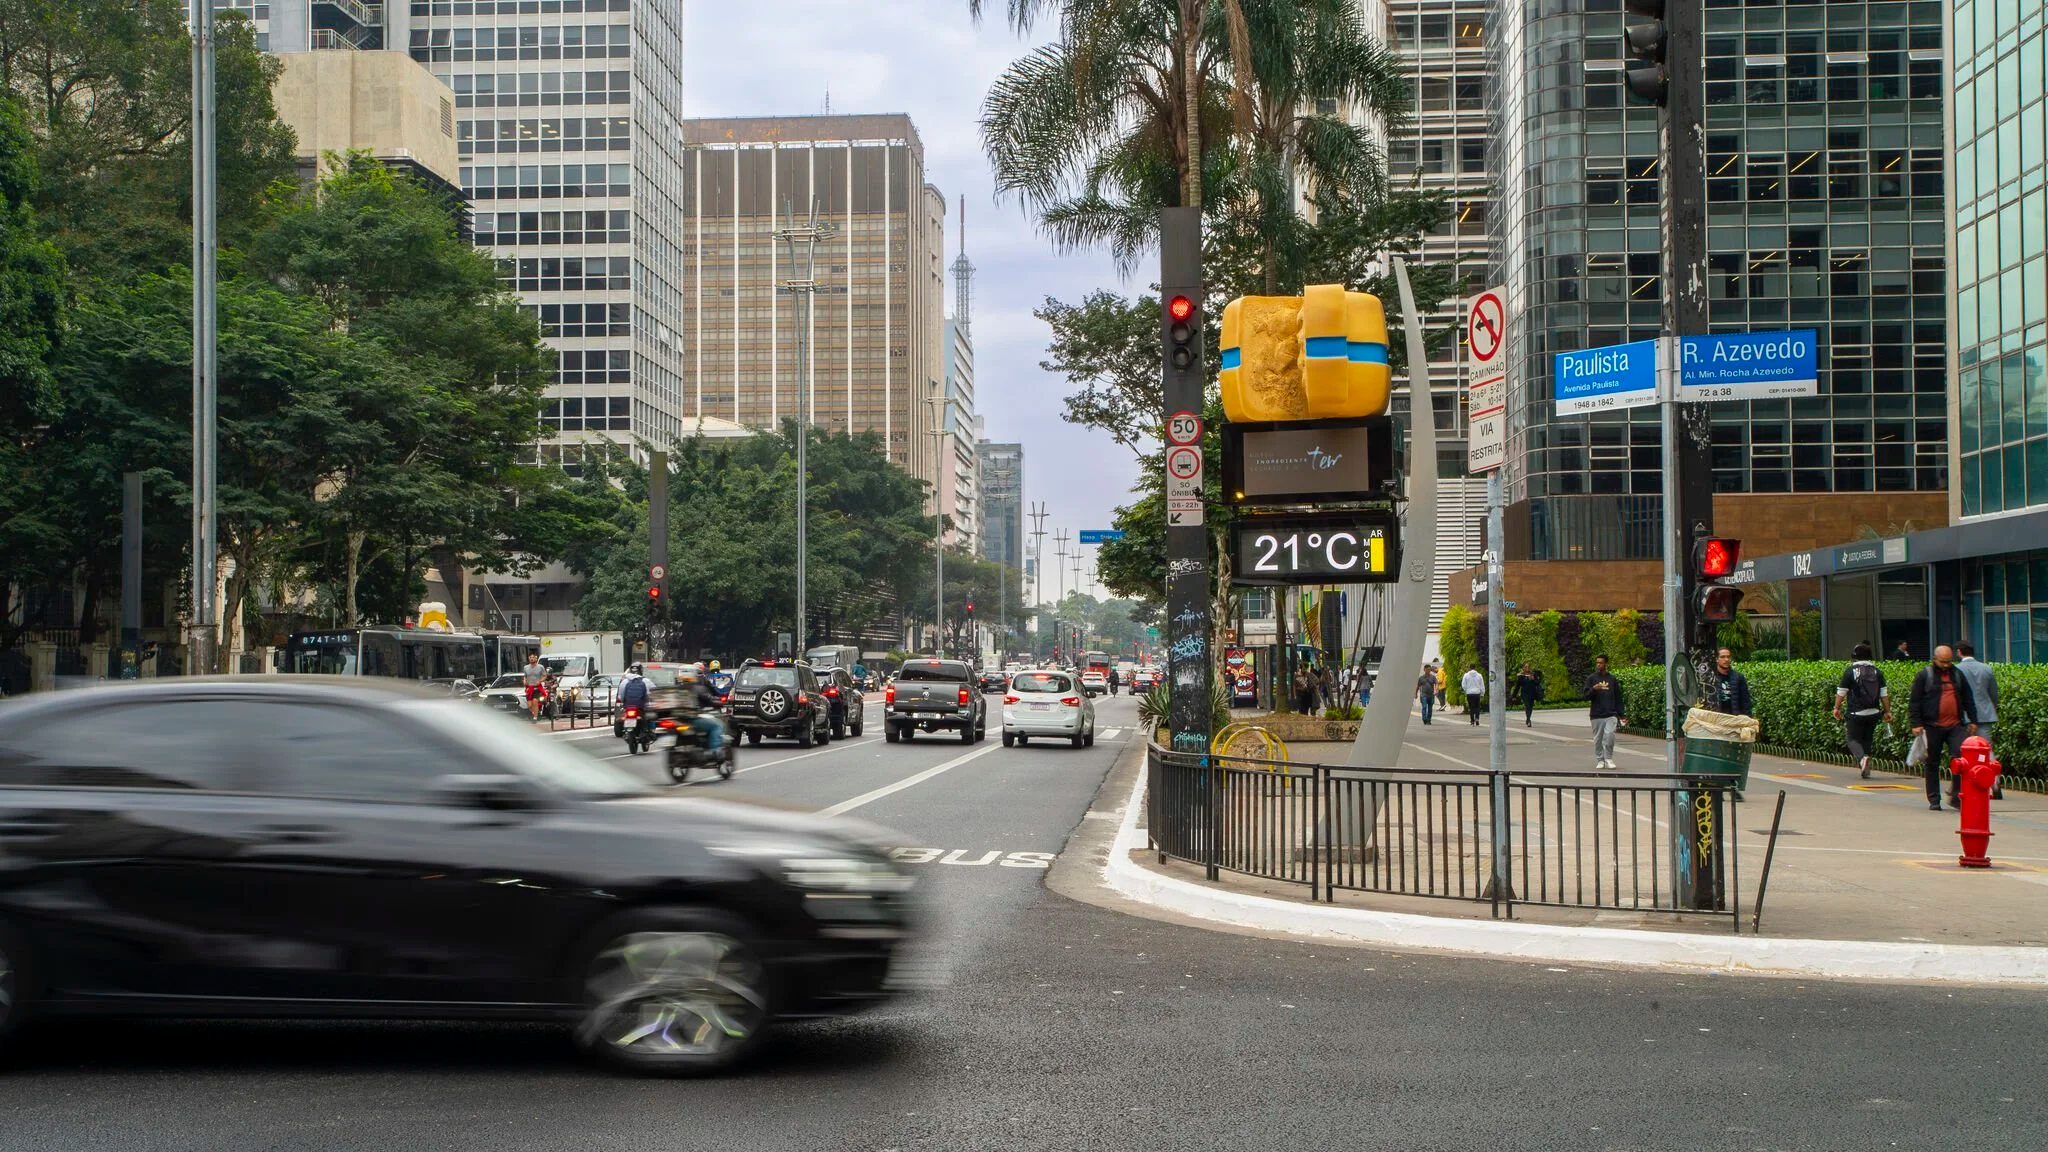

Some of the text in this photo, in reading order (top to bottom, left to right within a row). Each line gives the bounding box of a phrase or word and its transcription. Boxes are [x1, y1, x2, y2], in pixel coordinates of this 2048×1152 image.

[1683, 337, 1806, 364] R. Azevedo
[1470, 361, 1505, 382] CAMINHÃO
[1563, 351, 1629, 379] Paulista
[1698, 371, 1717, 379] Min.
[1720, 368, 1750, 377] Rocha
[1752, 366, 1794, 375] Azevedo
[1563, 380, 1620, 393] Avenida Paulista
[1699, 389, 1710, 397] 72
[1720, 388, 1732, 396] 38
[1574, 401, 1590, 409] 1948
[1598, 398, 1614, 406] 1842
[1173, 419, 1195, 434] 50
[1480, 422, 1494, 437] VIA
[1470, 442, 1503, 461] RESTRITA
[1180, 480, 1191, 488] SÓ
[1171, 488, 1202, 497] ÔNIBU
[1370, 530, 1384, 538] AR
[1254, 532, 1358, 571] 21°C
[1792, 554, 1812, 576] 1842
